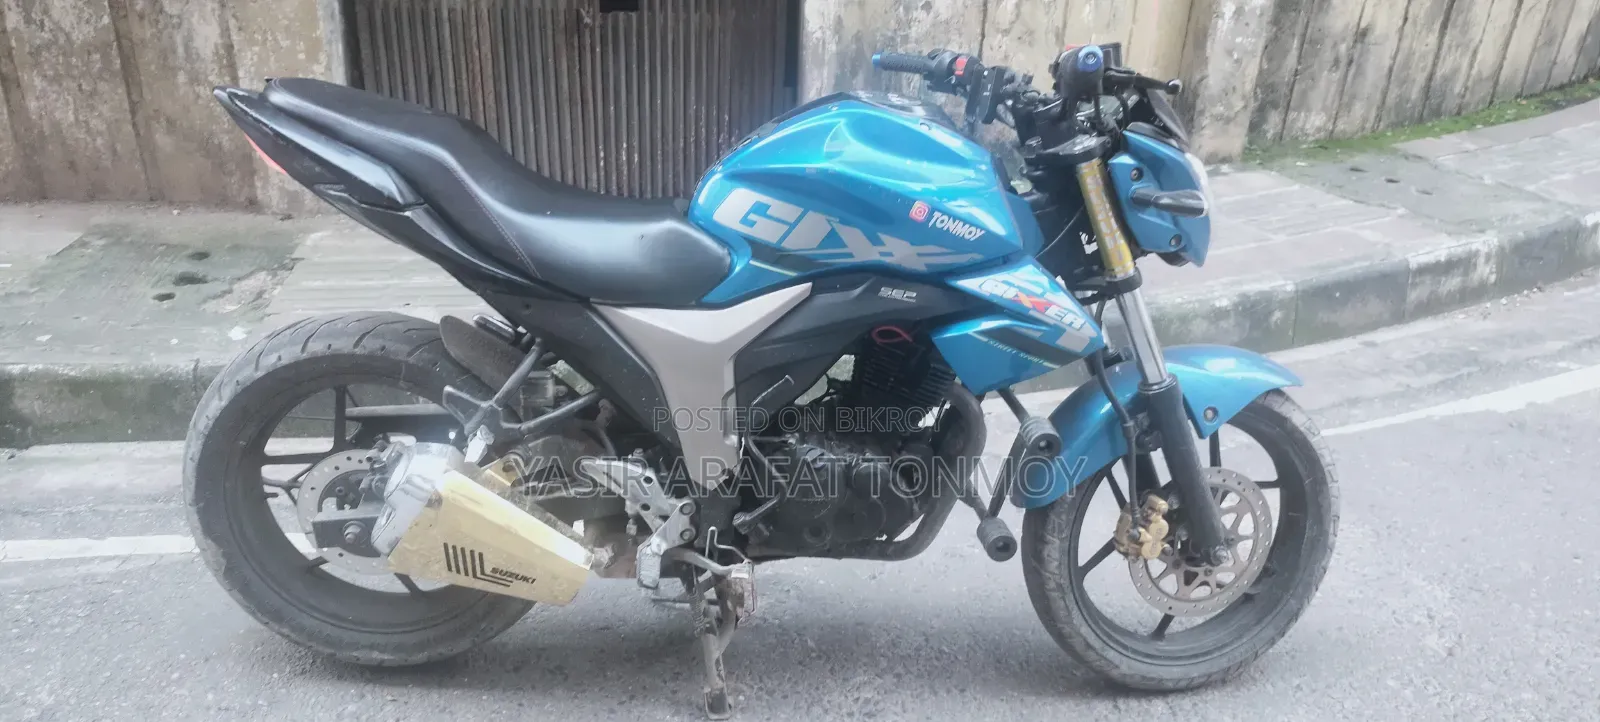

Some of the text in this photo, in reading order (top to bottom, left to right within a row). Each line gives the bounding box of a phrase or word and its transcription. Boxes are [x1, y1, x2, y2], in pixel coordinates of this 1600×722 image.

[928, 210, 986, 241] TONMOY
[980, 279, 1086, 331] GIXXER
[490, 567, 536, 584] SUZUKI
